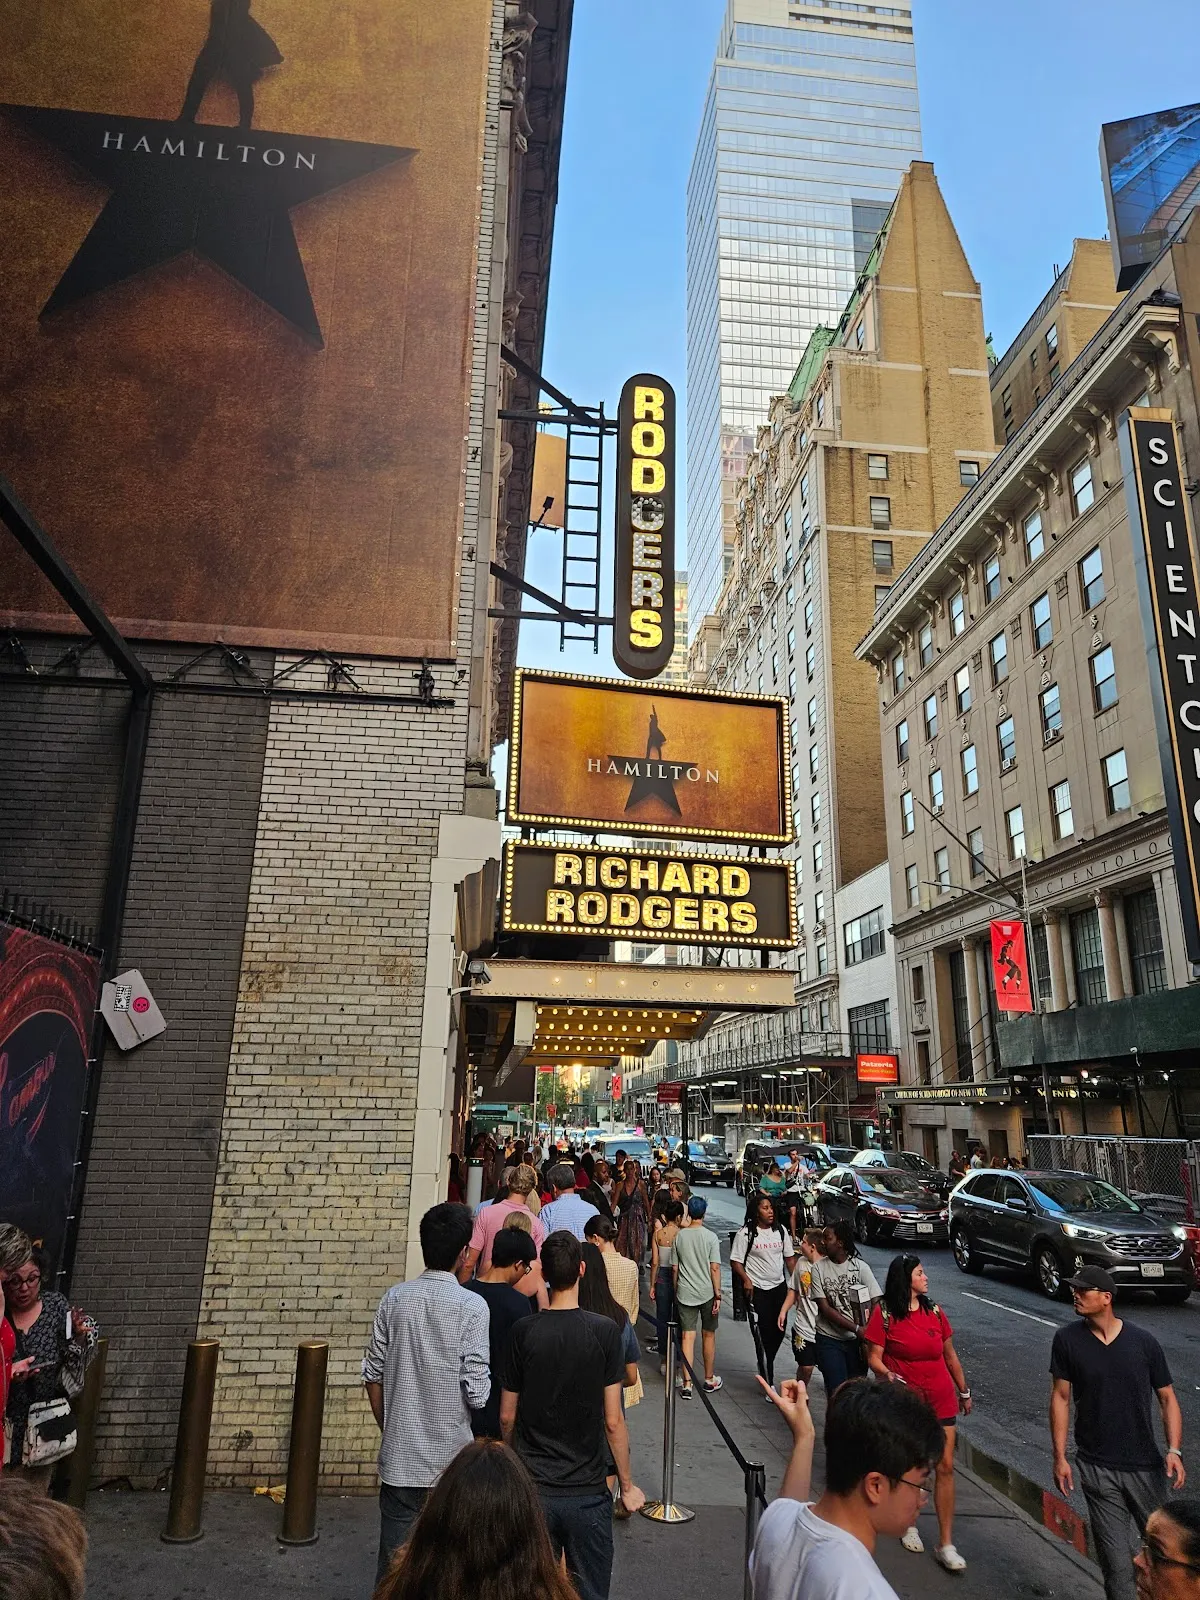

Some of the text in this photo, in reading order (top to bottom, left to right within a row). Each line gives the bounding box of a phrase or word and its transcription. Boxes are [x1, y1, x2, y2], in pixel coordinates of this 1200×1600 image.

[102, 130, 319, 171] HAMILTON
[629, 385, 666, 651] RODGERS
[587, 757, 721, 785] HAMILTON
[553, 853, 751, 899] RICHARD
[546, 888, 758, 936] RODGERS
[913, 916, 965, 944] CHURCH
